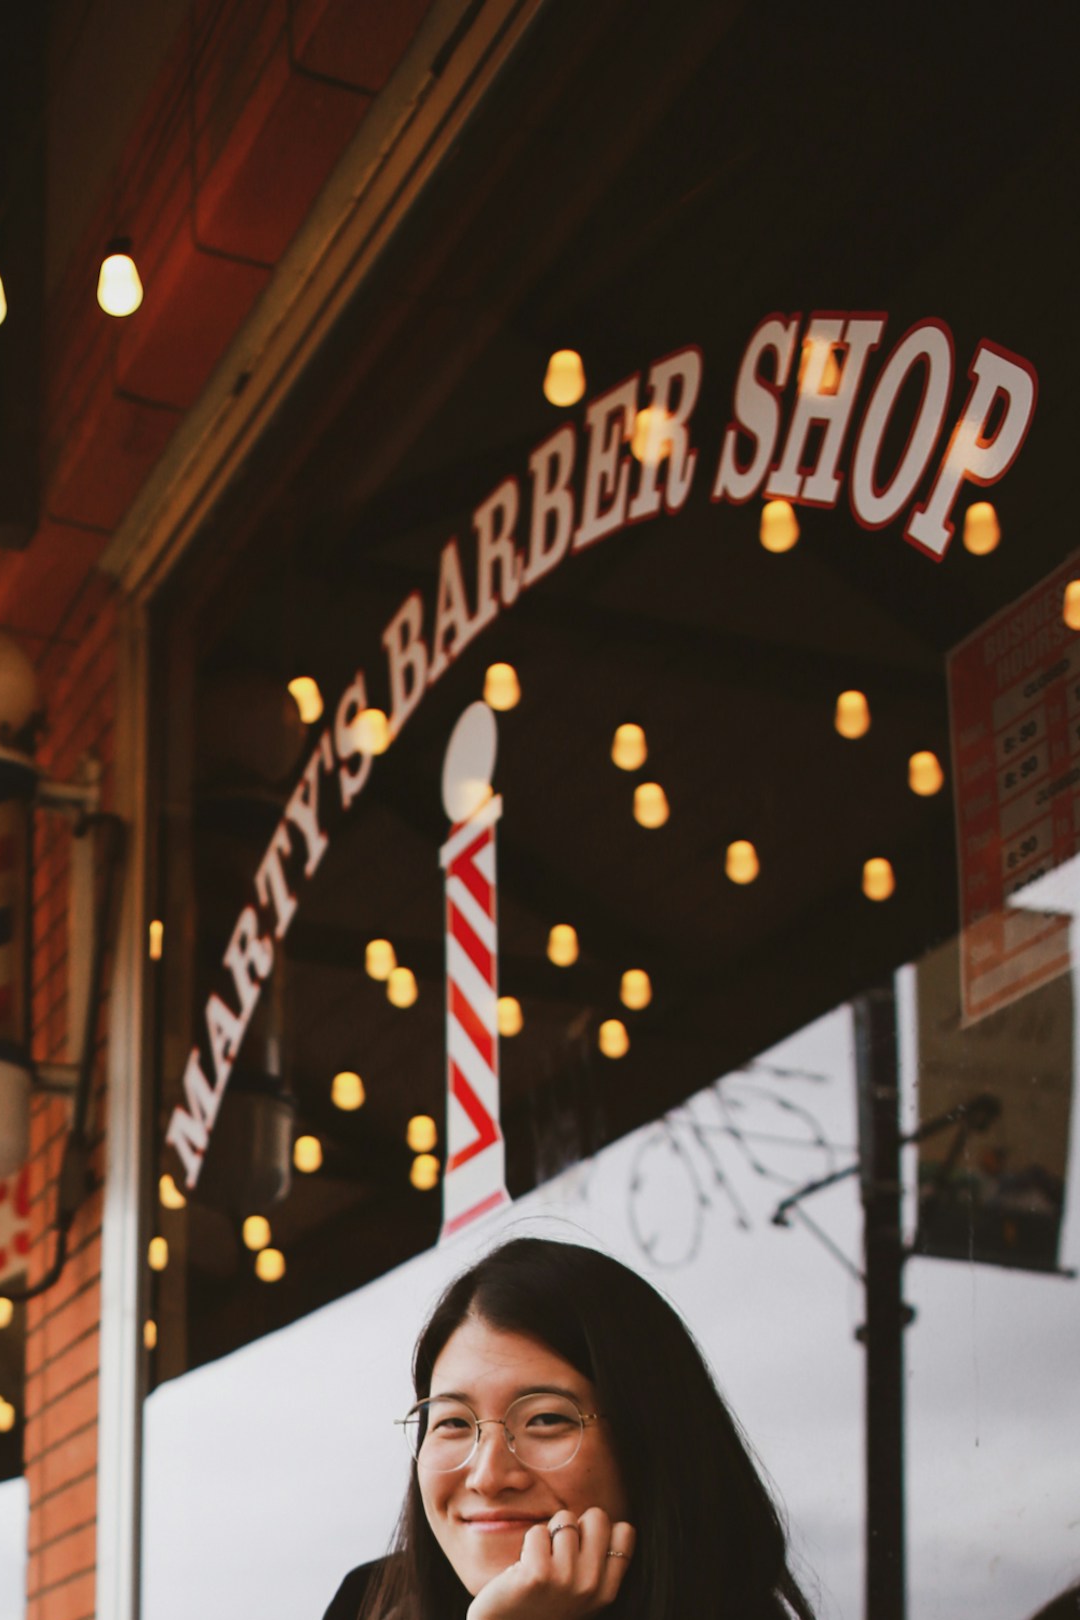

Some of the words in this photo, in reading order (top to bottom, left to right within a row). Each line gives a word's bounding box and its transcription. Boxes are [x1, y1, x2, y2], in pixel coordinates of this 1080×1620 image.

[165, 668, 375, 1190] MARTY'S
[381, 343, 704, 742] BARBER
[710, 309, 1040, 564] SHOP
[983, 567, 1079, 667] BUSINES
